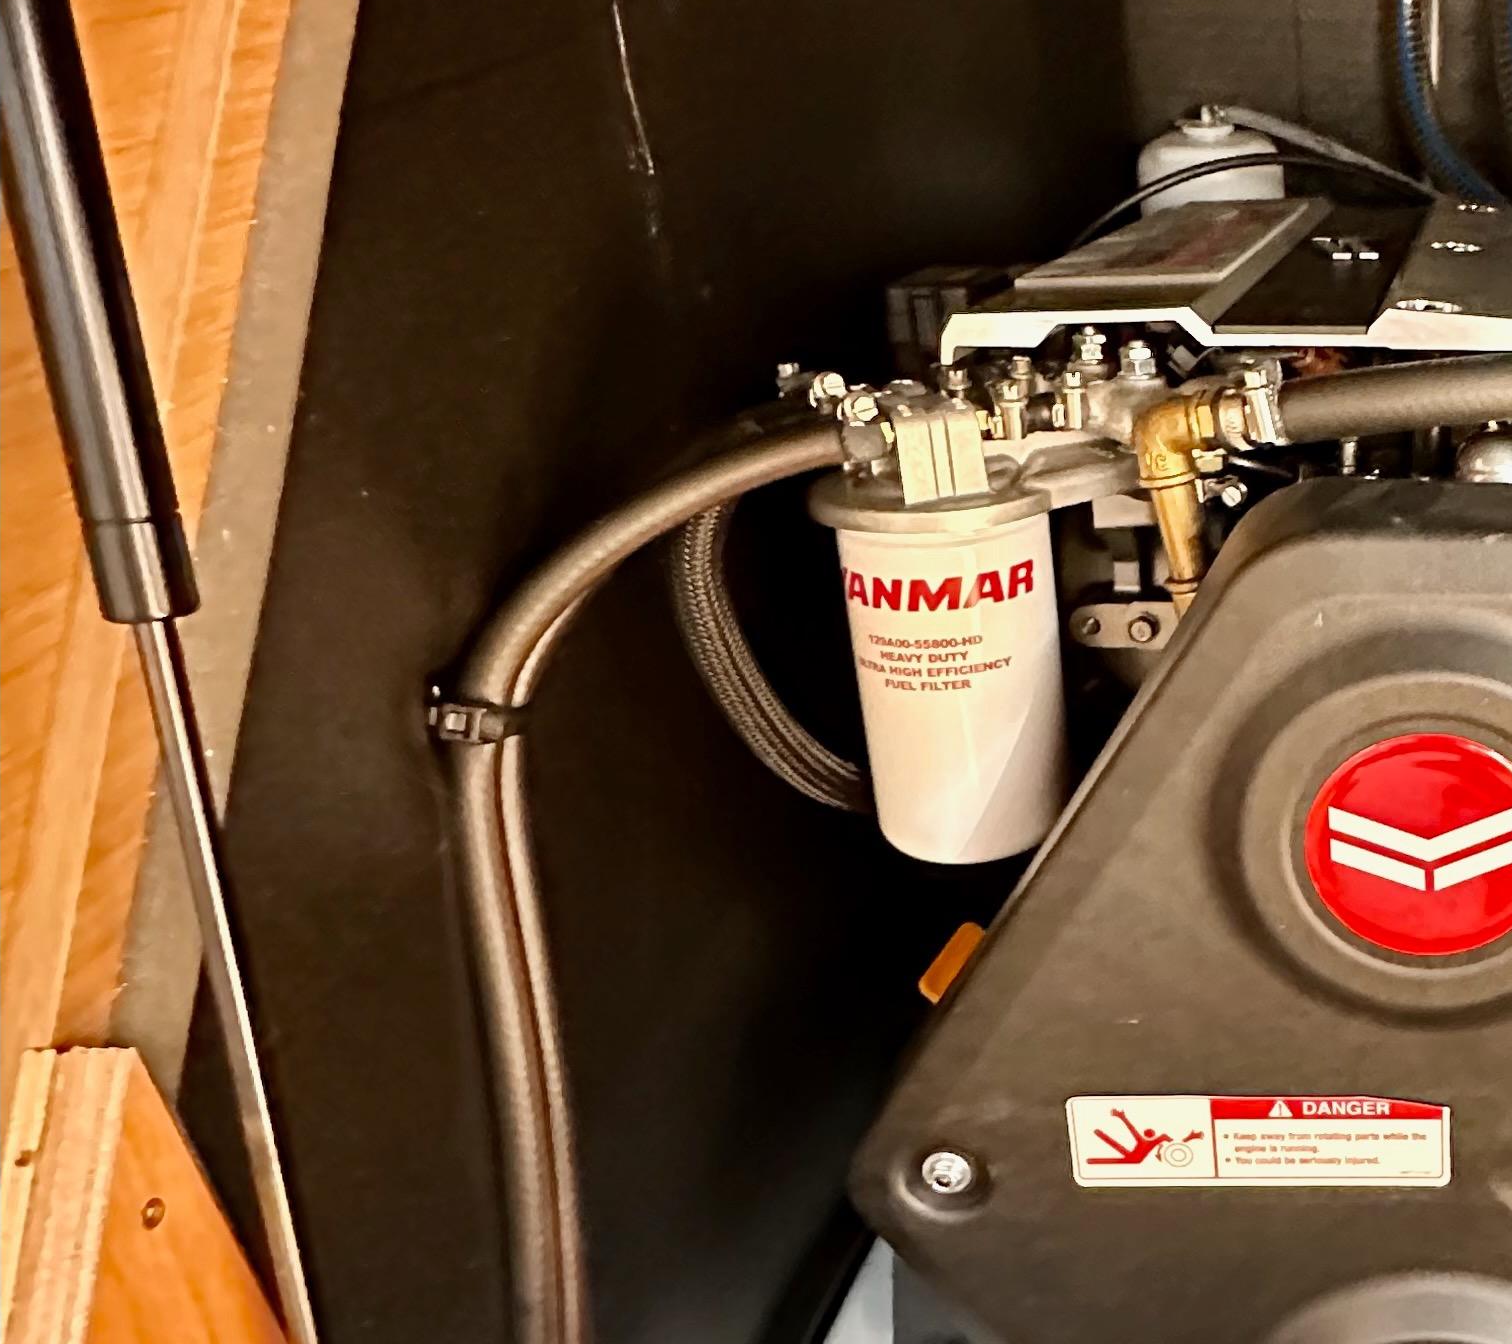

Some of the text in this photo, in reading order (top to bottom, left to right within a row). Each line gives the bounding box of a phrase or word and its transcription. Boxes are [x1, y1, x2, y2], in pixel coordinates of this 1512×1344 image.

[880, 650, 969, 663] HEAVY DUTY
[889, 666, 923, 677] HIGH
[927, 656, 1013, 678] EFFICIENCY
[885, 678, 972, 692] FUEL FILTER
[1301, 1100, 1392, 1116] DANGER
